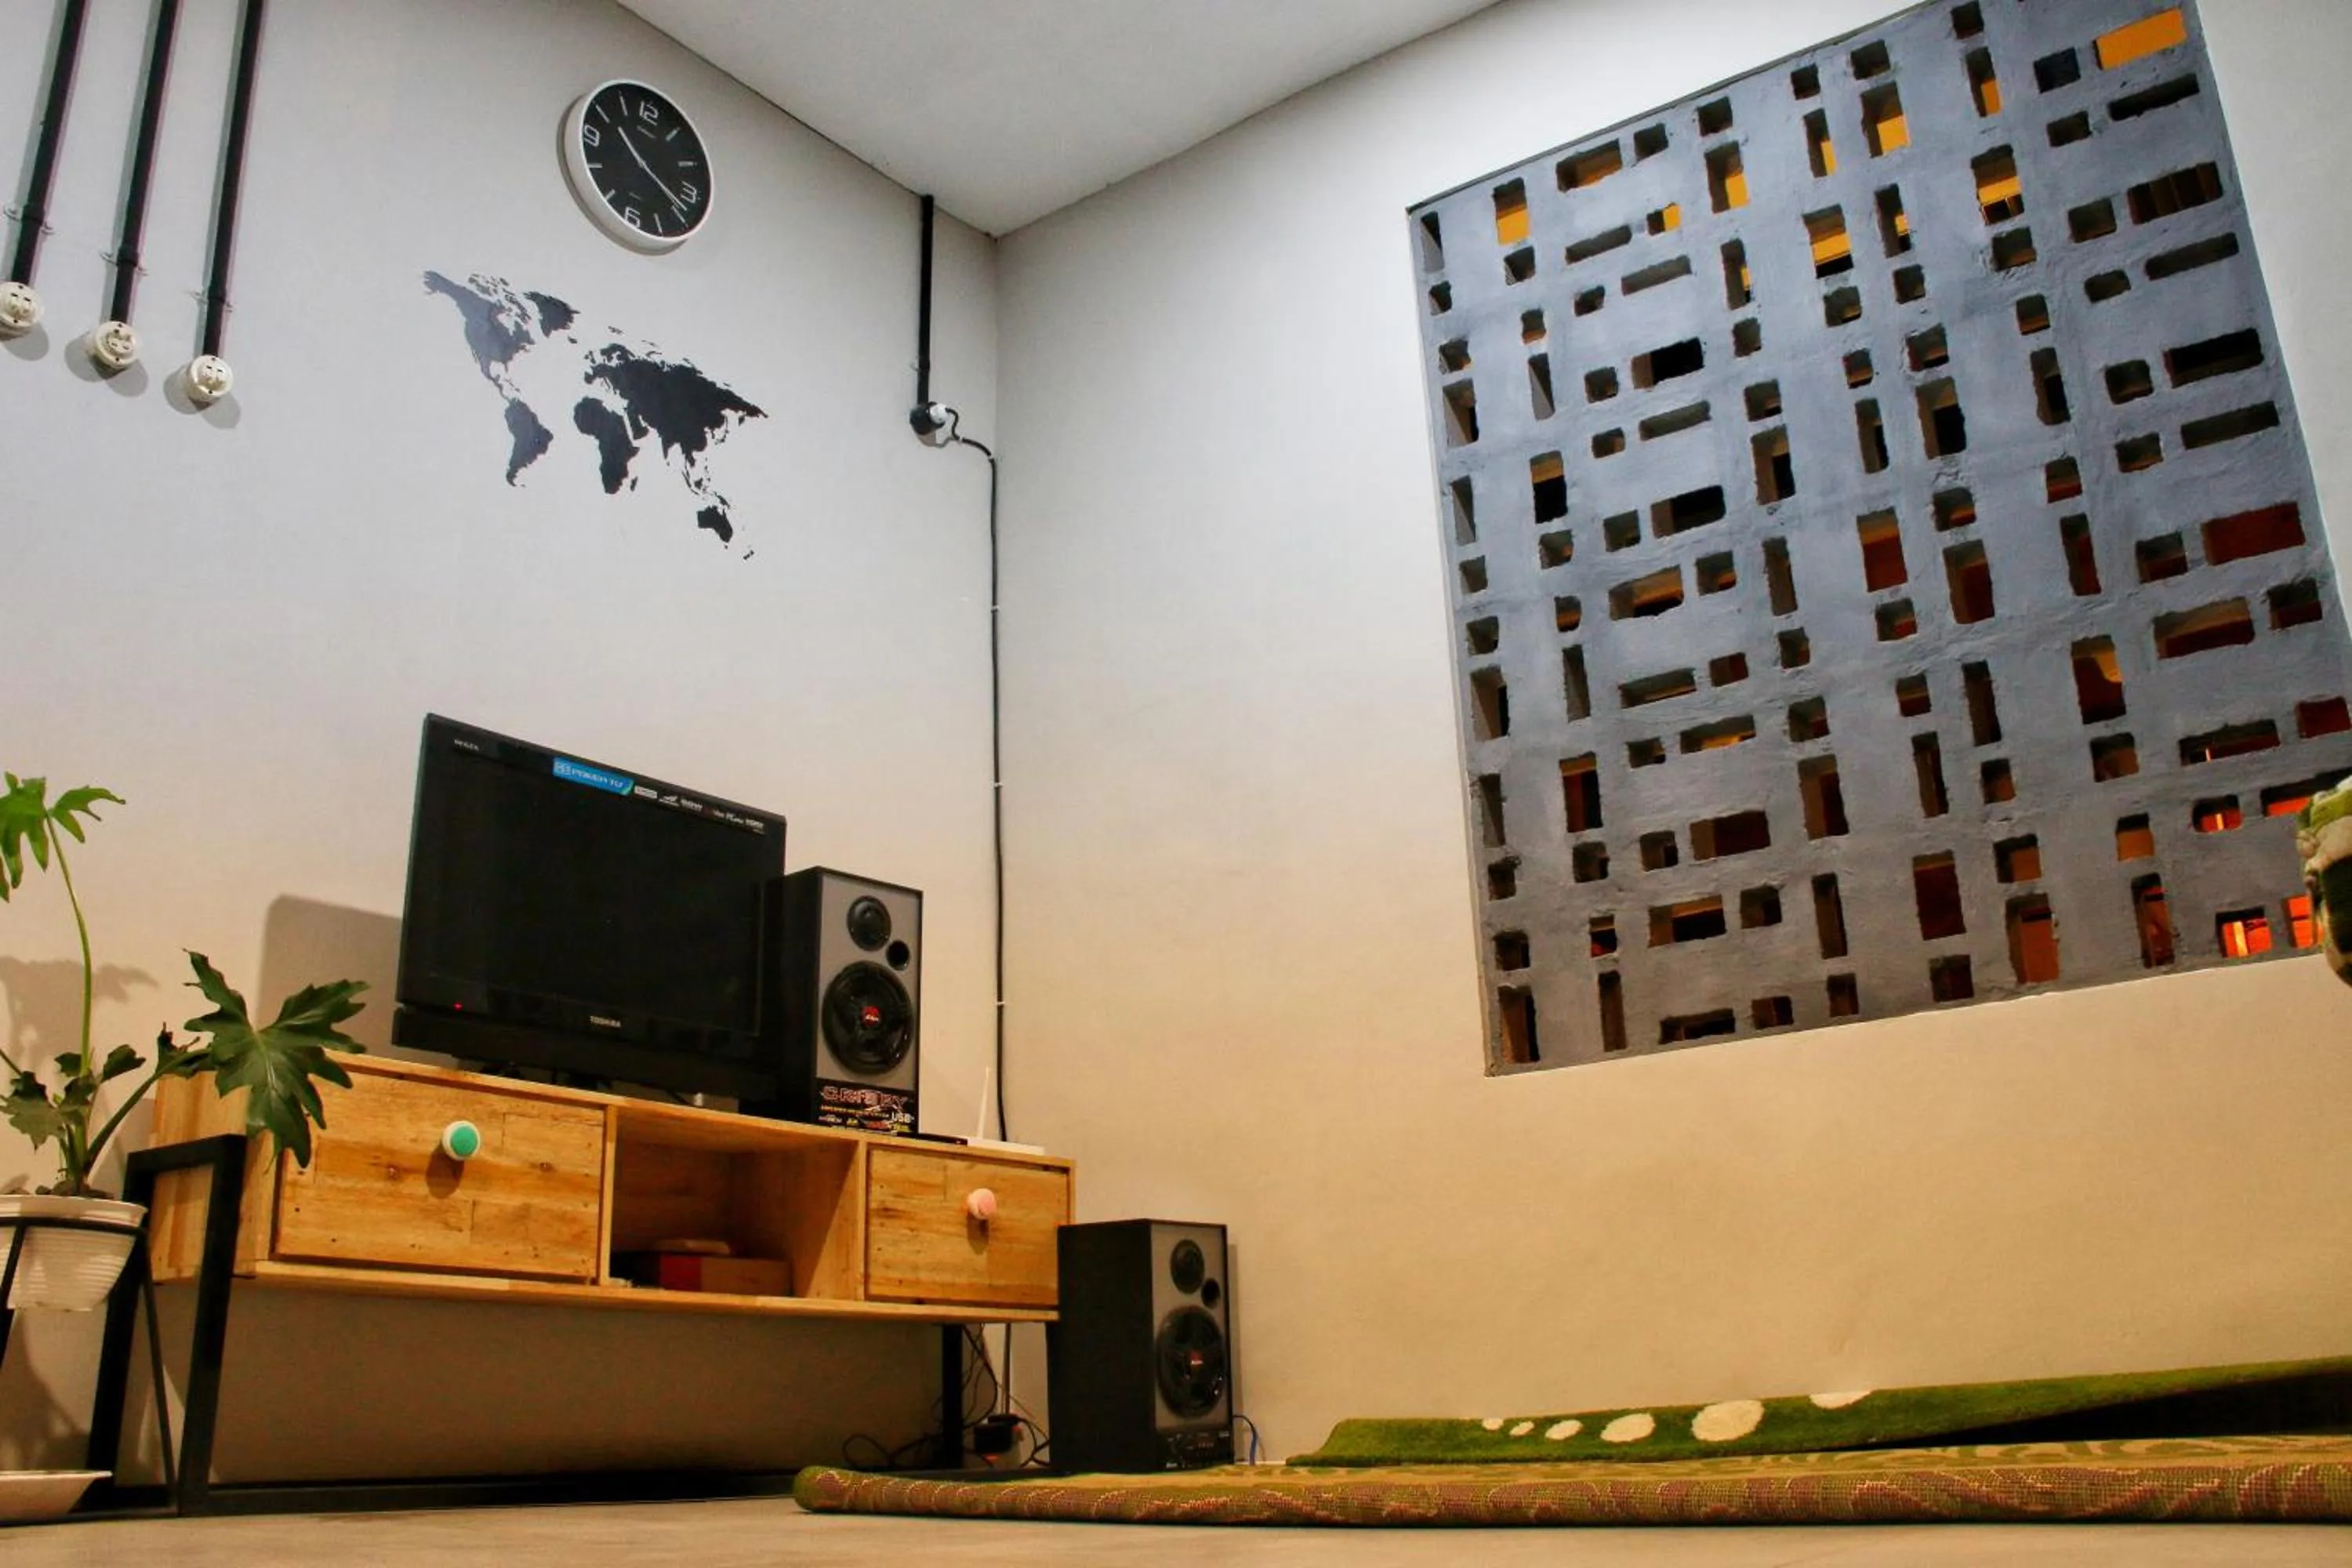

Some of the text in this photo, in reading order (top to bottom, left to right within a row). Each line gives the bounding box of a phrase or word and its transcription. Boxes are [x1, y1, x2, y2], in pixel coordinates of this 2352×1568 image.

[639, 100, 659, 126] 12
[583, 124, 601, 147] 9
[680, 180, 698, 204] 3
[624, 206, 641, 229] 6
